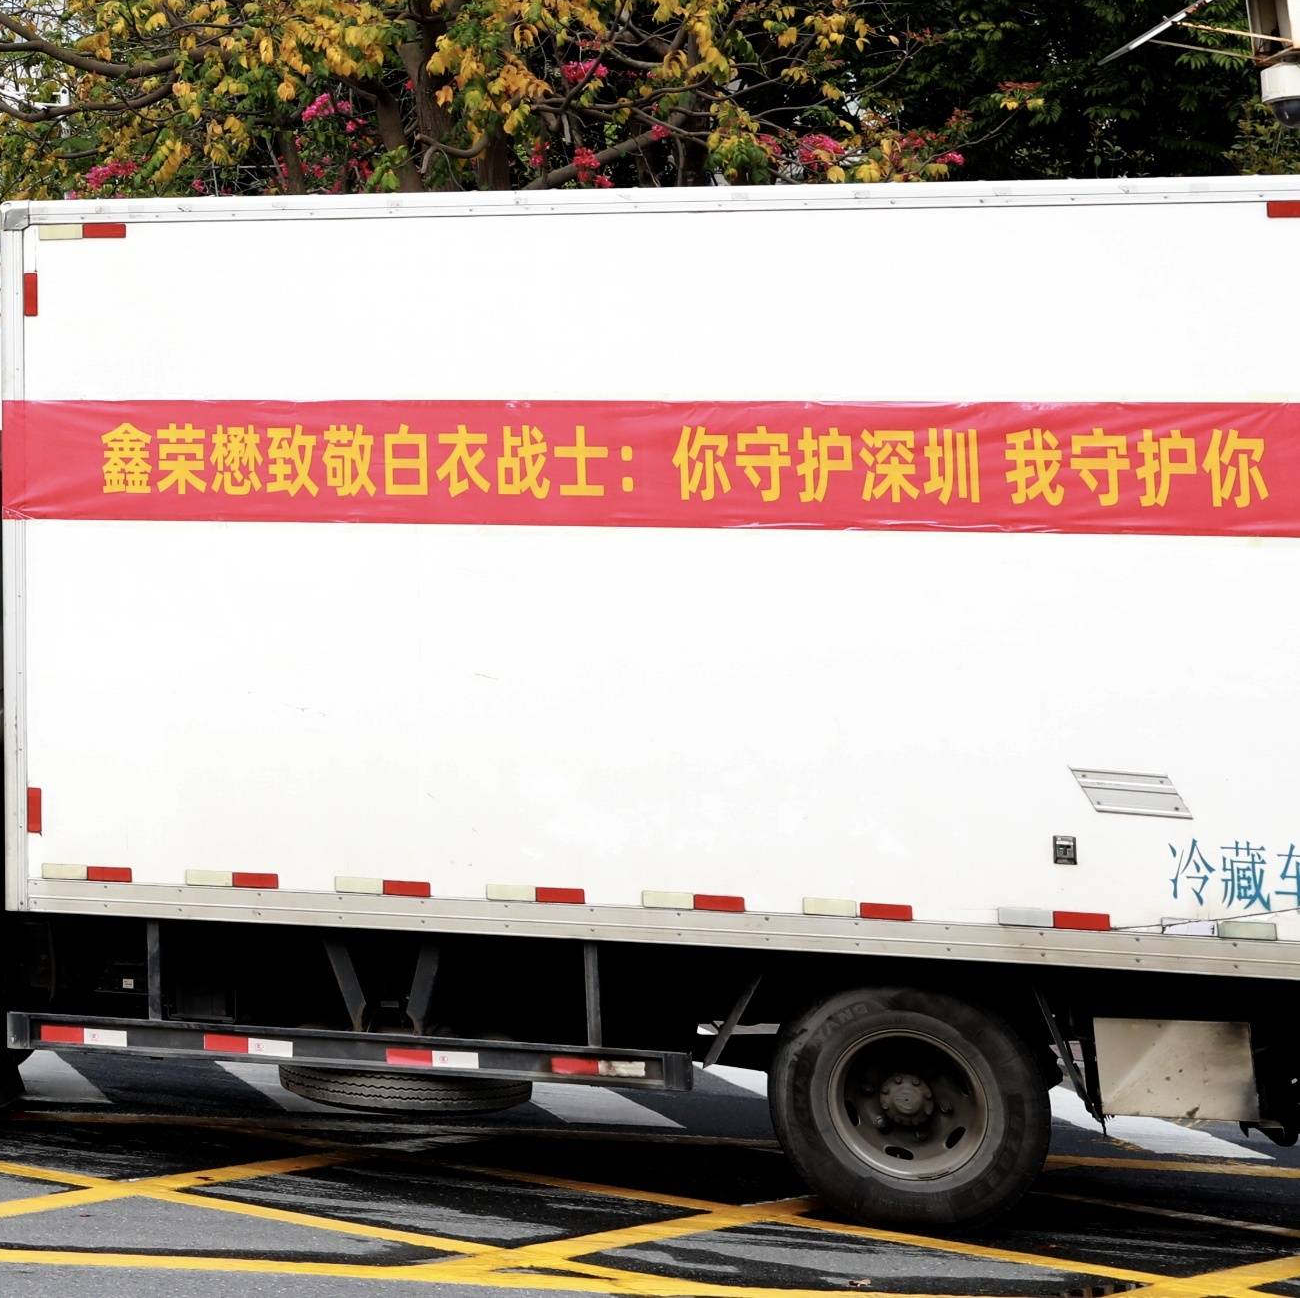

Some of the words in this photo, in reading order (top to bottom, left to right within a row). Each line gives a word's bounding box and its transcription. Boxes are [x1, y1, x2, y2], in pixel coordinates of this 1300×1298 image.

[672, 426, 980, 505] 你守护深圳
[1004, 428, 1268, 507] 我守护你
